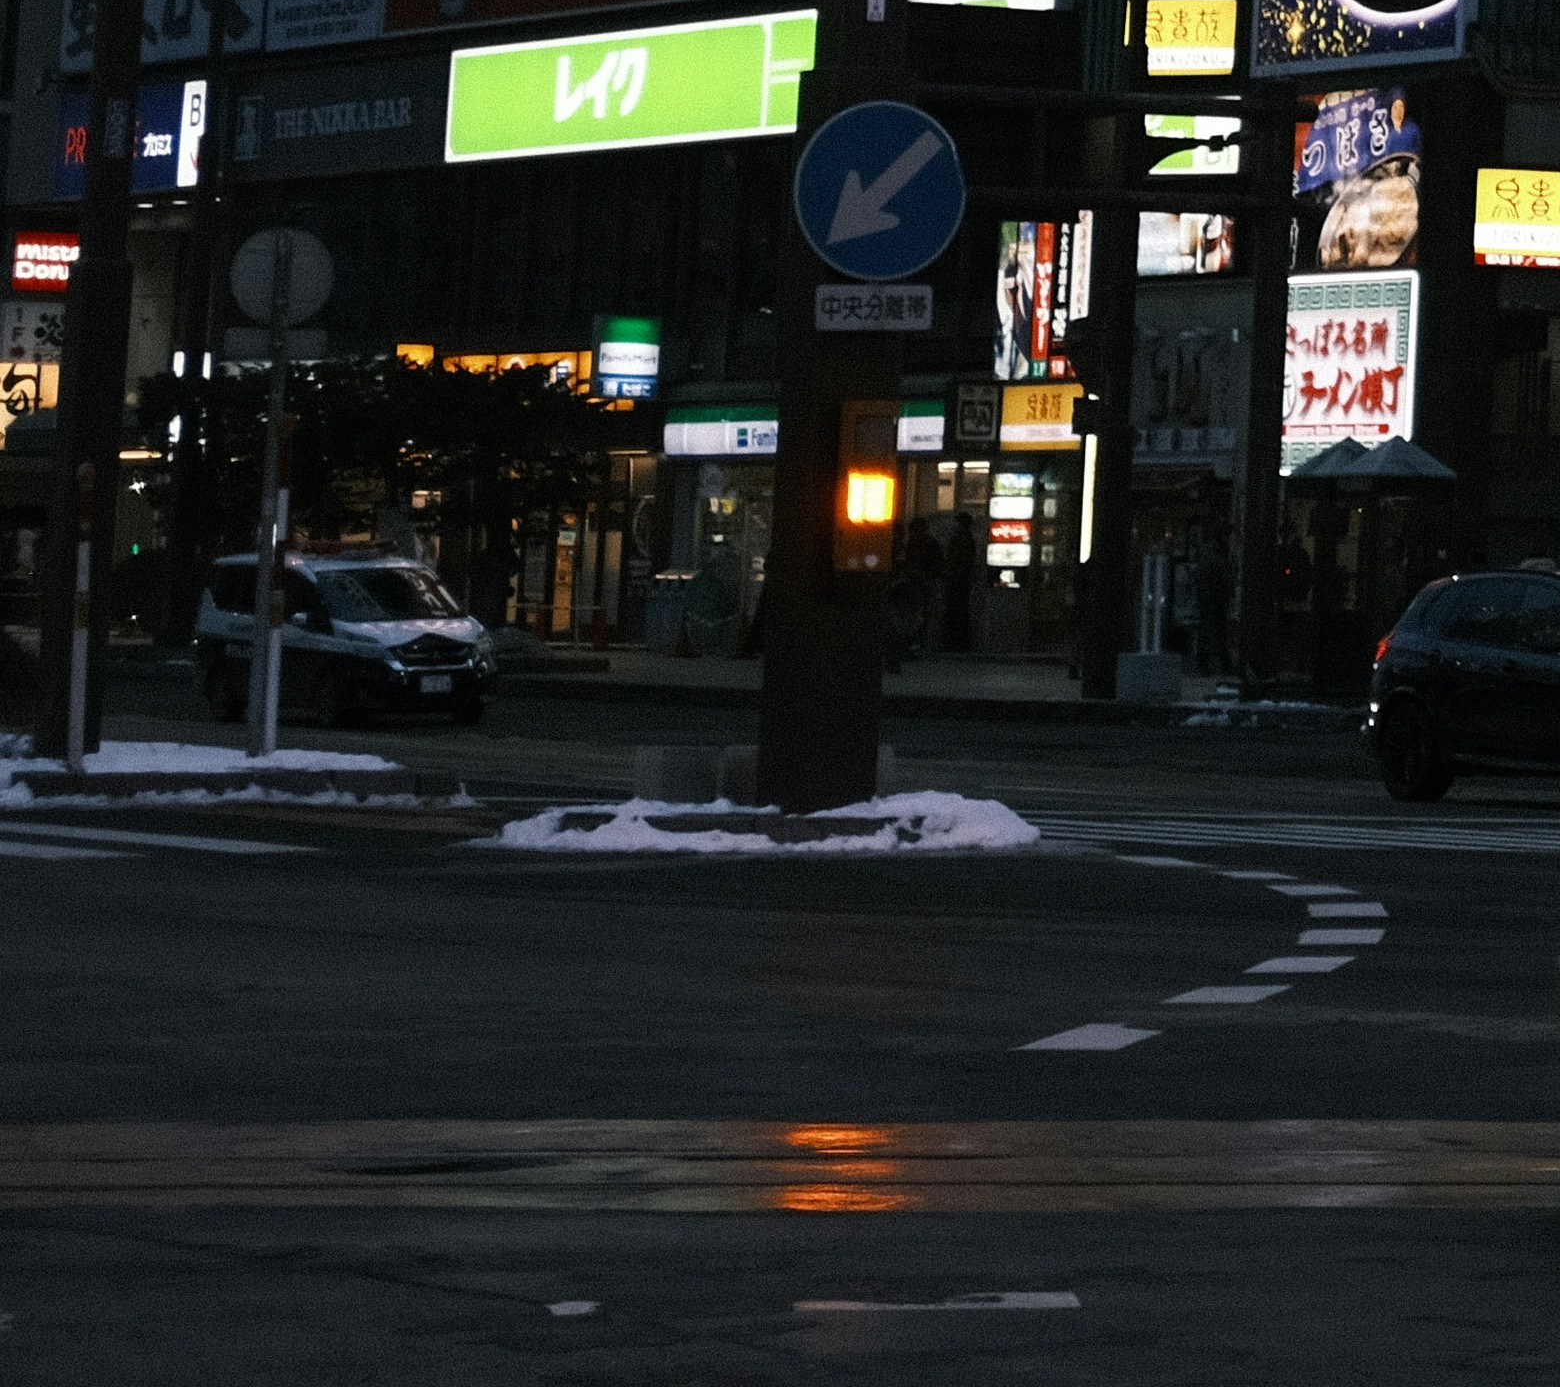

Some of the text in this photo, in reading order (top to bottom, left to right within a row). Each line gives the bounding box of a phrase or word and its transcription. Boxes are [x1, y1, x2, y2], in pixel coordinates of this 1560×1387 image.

[554, 47, 649, 123] レイク
[273, 98, 412, 139] THE NIKKA BAR
[821, 291, 928, 322] 中央分離帯
[1300, 366, 1405, 415] ラーメン横丁
